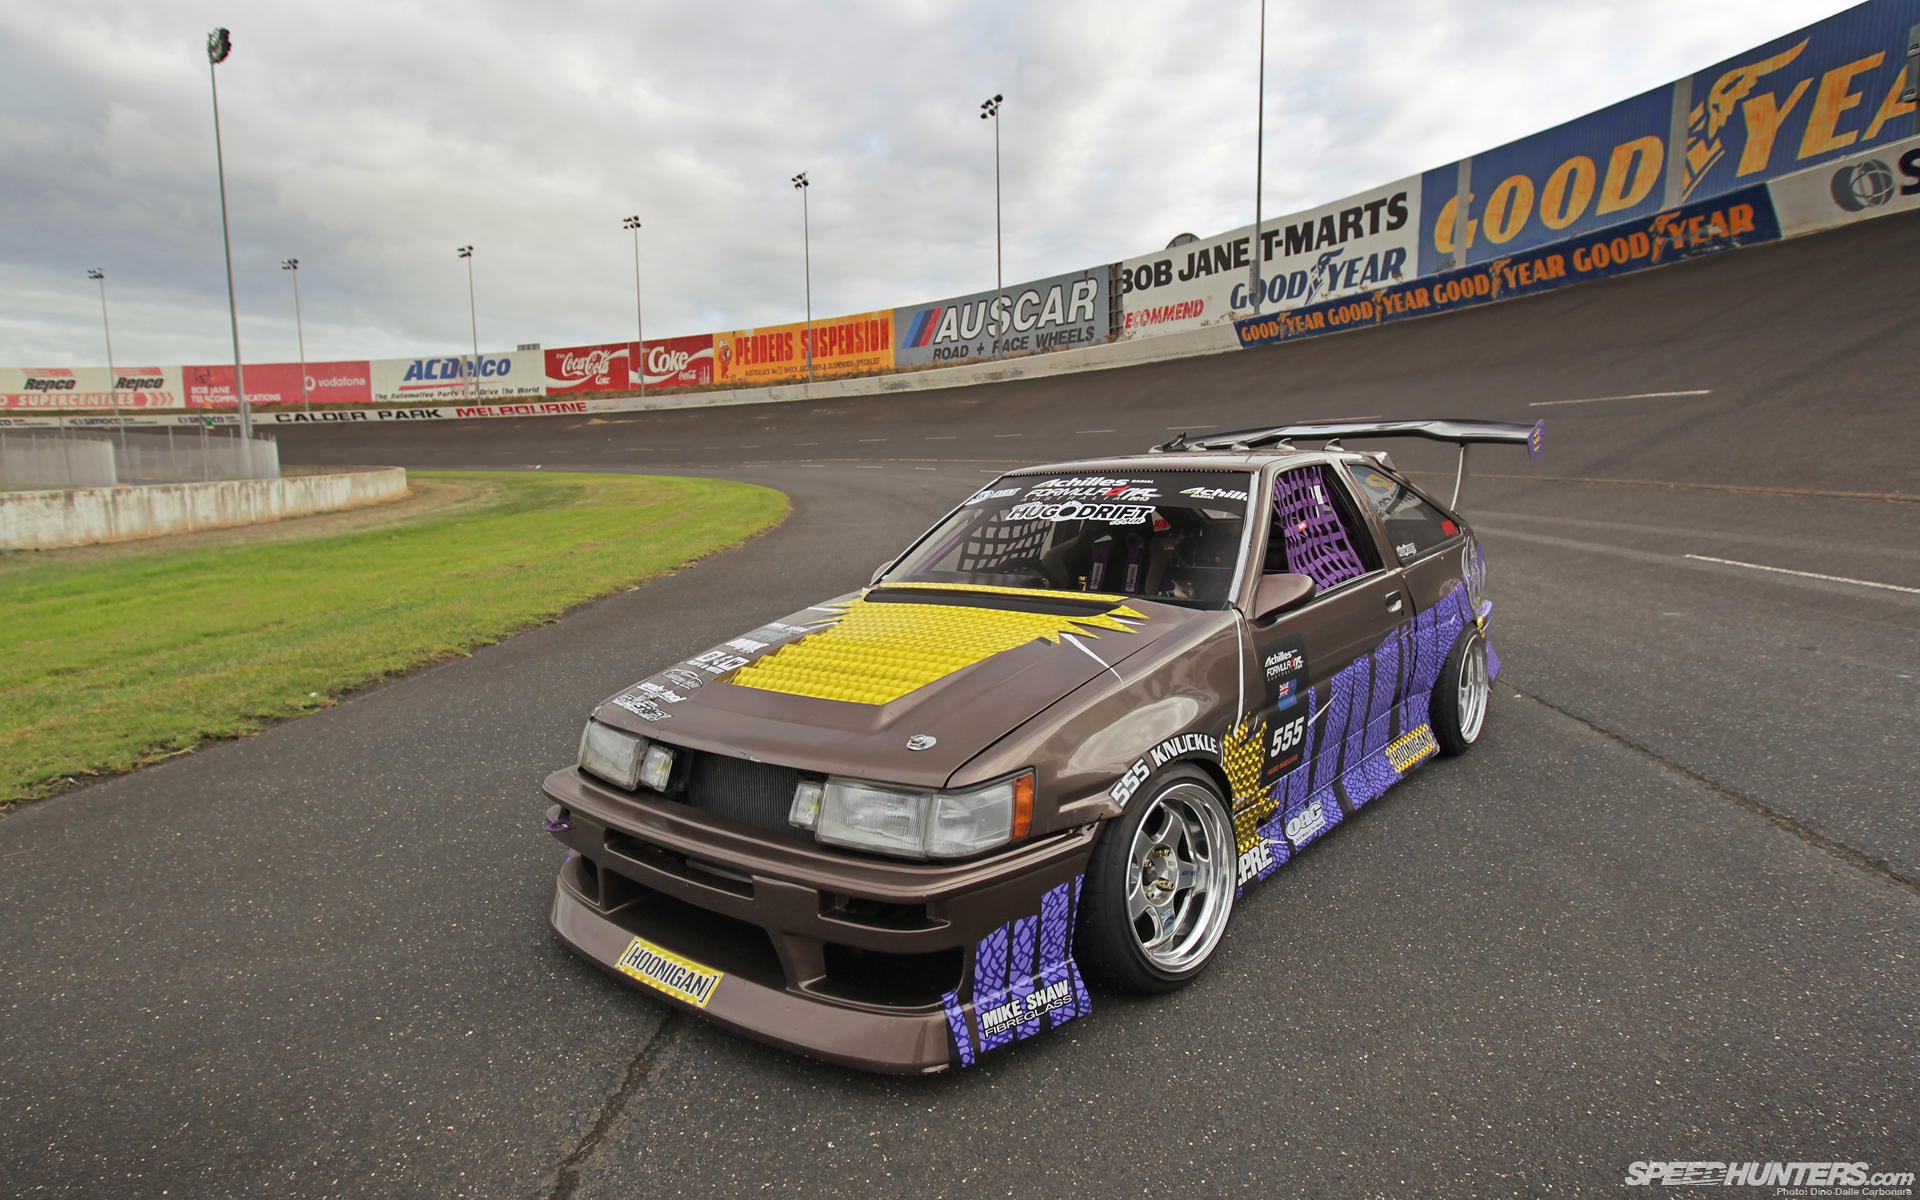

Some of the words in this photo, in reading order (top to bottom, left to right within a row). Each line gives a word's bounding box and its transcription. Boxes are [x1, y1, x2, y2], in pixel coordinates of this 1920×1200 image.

[1178, 237, 1251, 282] JANE
[1260, 191, 1408, 263] T-MARTS
[933, 277, 1098, 345] AUSCAR
[735, 332, 793, 366] PEDDERS
[800, 317, 889, 360] SUSPENSION
[933, 344, 969, 360] ROAD
[992, 335, 1030, 355] RACE
[1035, 325, 1095, 349] WHEELS
[403, 355, 511, 381] ACDelco
[649, 346, 688, 373] Coke
[24, 377, 76, 393] Repco
[114, 377, 164, 391] Repco
[191, 386, 209, 395] BOB
[317, 376, 366, 387] vodafone
[517, 386, 540, 394] World
[275, 411, 368, 423] CALDER
[377, 409, 443, 420] PARK
[455, 402, 588, 418] MELBOURNE
[1032, 477, 1129, 488] Achilles
[1265, 650, 1292, 667] Achilles
[1270, 716, 1304, 758] 555
[1110, 758, 1150, 807] 555
[1150, 733, 1219, 768] KNUCKLE
[981, 1000, 1021, 1030] MIKE
[1025, 979, 1069, 1010] SHAW
[985, 993, 1073, 1038] FIBREGLASS
